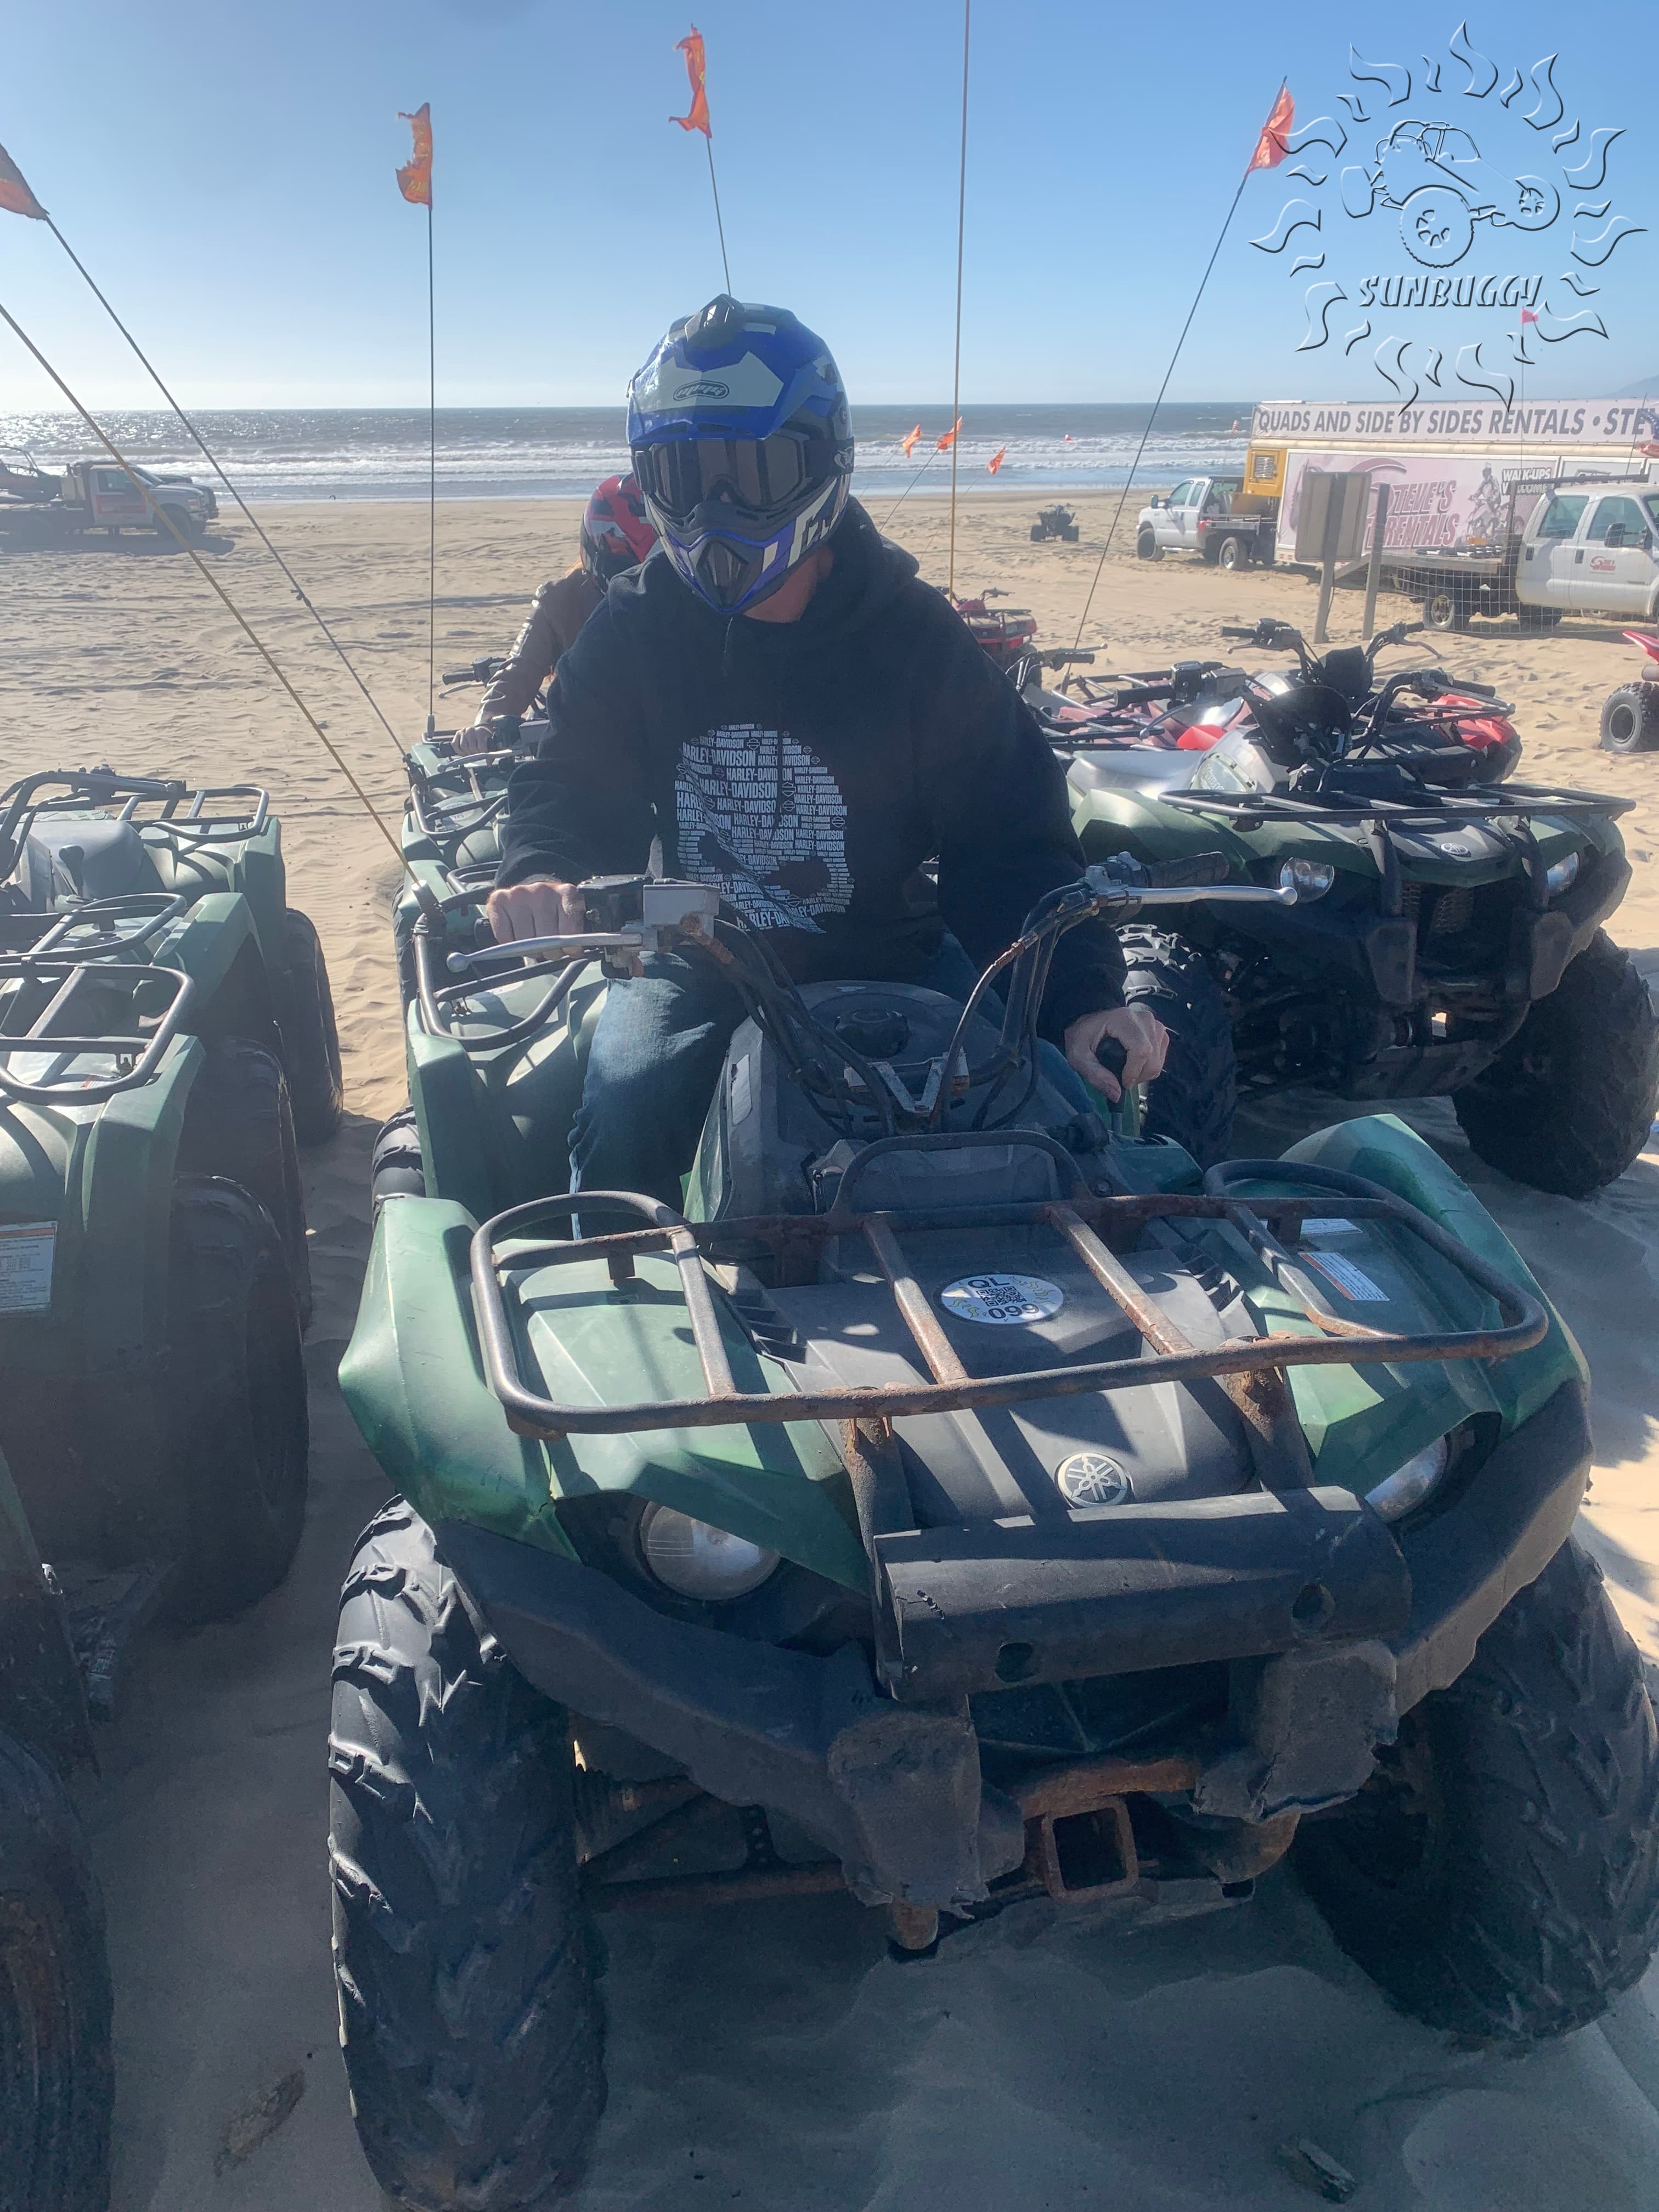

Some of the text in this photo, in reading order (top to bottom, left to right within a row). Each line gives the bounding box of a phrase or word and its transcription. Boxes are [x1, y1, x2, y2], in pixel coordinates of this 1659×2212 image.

[1258, 408, 1656, 435] QUADS AND SIDE BY SIDES RENTALS STE
[682, 741, 756, 767] HARLEY-DAVIDSON
[699, 777, 777, 799] HARLEY-DAVIDSON
[795, 839, 845, 851] HARLEY-DAVIDSON
[967, 1277, 1009, 1289] QL
[988, 1303, 1040, 1319] 099
